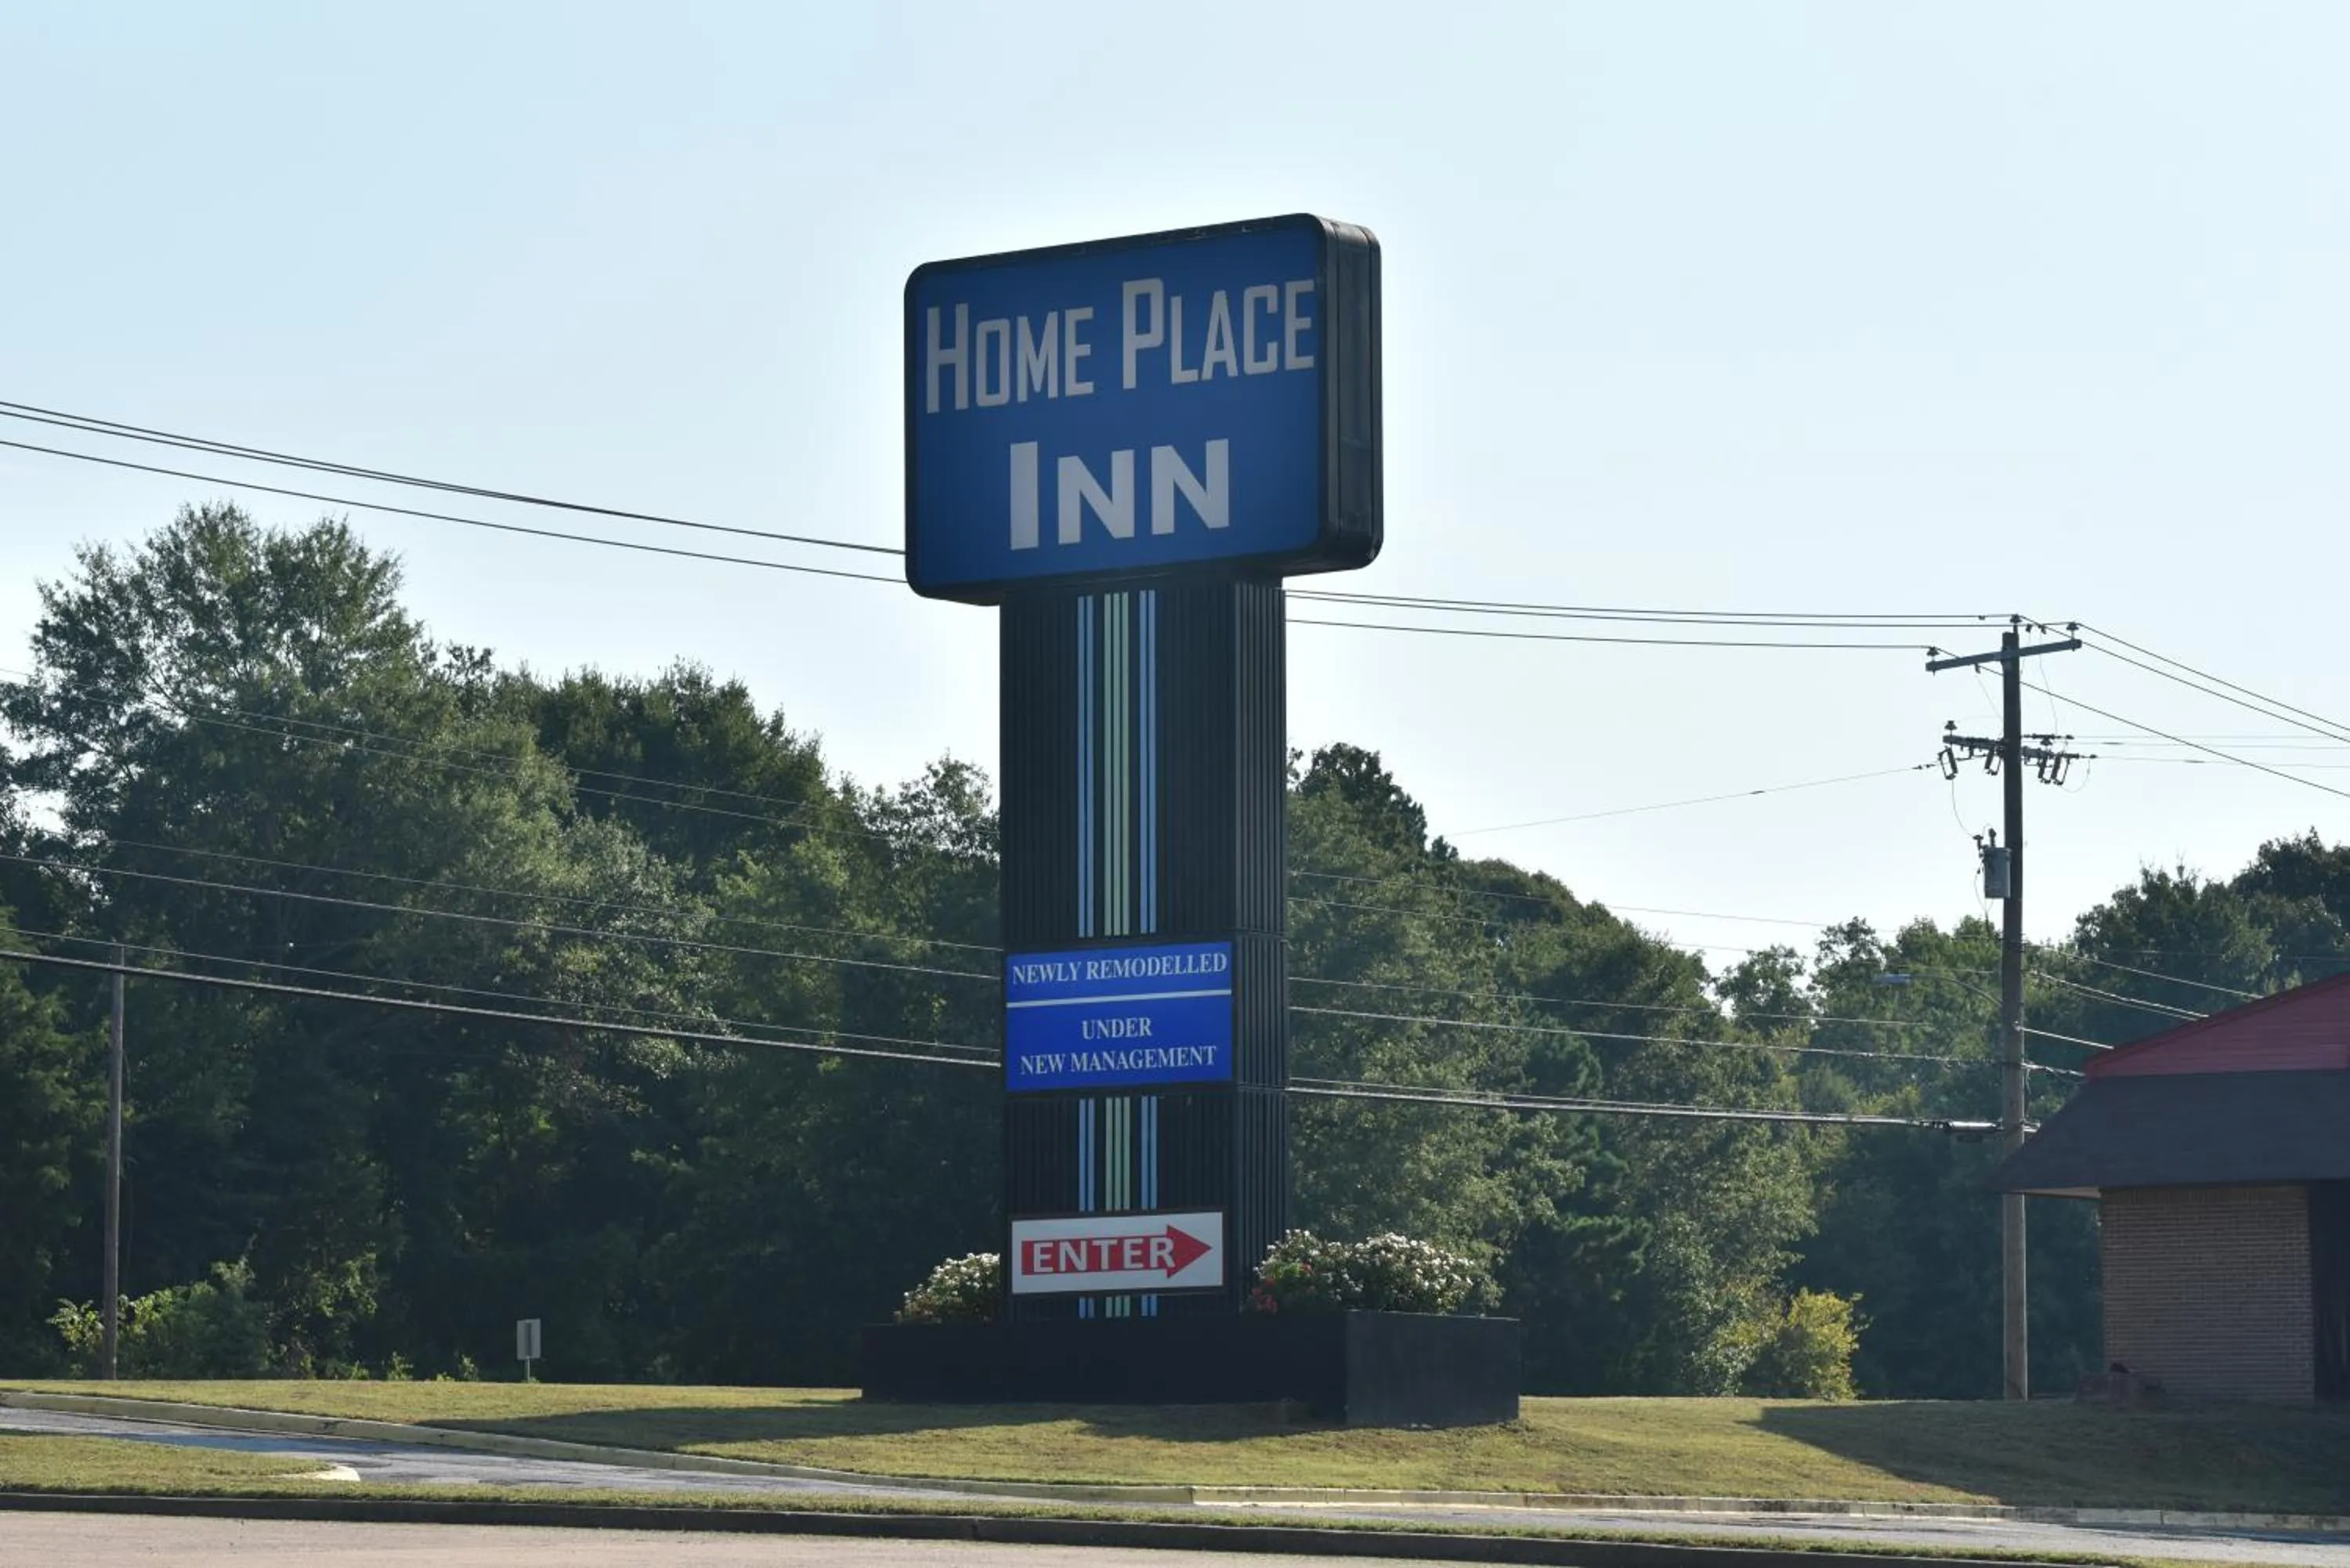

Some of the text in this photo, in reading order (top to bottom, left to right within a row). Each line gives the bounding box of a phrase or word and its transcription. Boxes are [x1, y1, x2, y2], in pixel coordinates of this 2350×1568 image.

[927, 278, 1315, 414] HOME PLACE
[1010, 439, 1229, 550] INN
[1012, 952, 1227, 985] NEWLY REMODELLED
[1082, 1017, 1152, 1039] UNDER
[1021, 1046, 1217, 1075] NEW MANAGEMENT
[1033, 1237, 1176, 1273] ENTER
